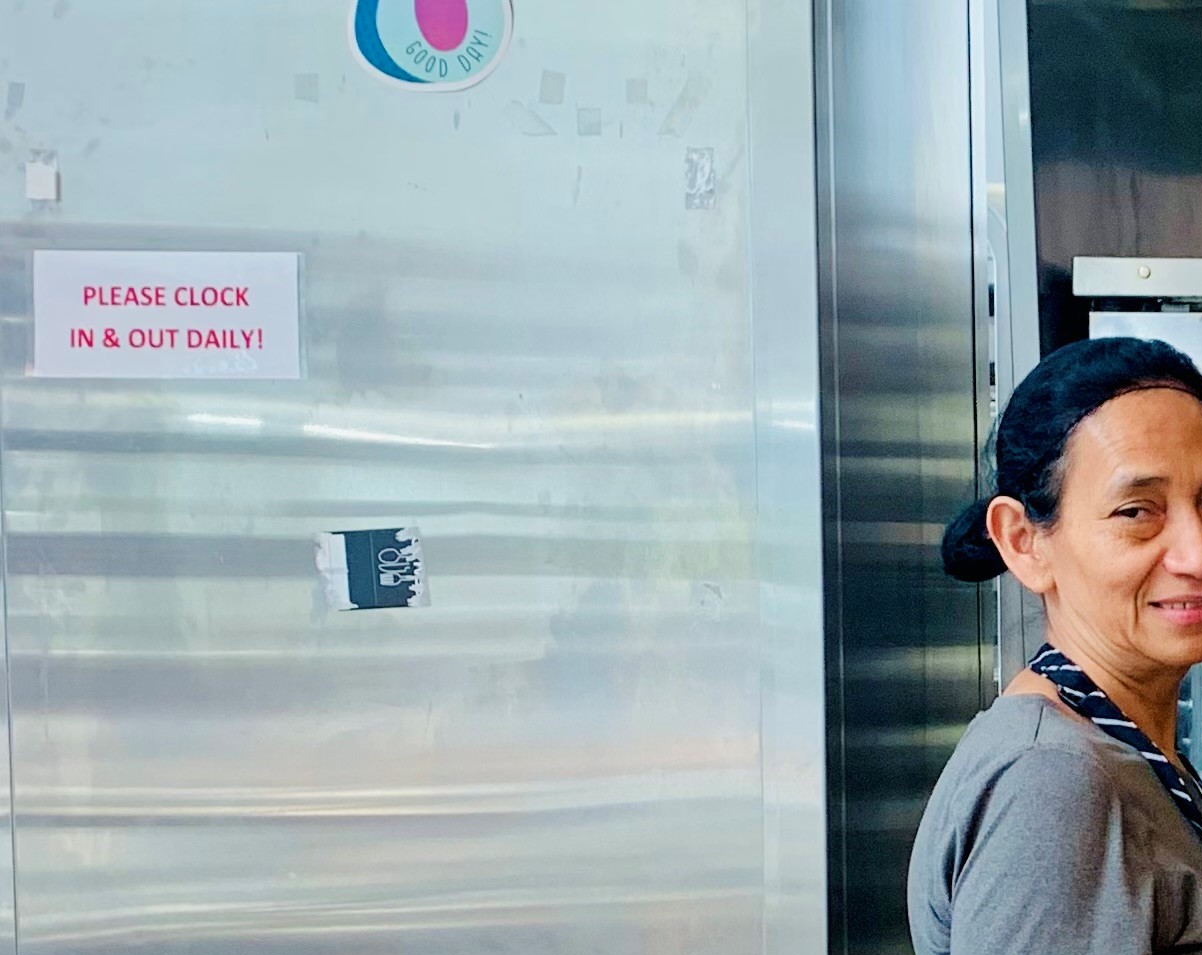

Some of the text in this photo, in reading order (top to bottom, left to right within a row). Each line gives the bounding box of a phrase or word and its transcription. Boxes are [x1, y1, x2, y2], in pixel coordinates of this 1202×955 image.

[405, 29, 492, 78] GOOD DAY!
[83, 286, 249, 307] PLEASE CLOCK
[70, 328, 264, 349] IN & OUT DAILY!
